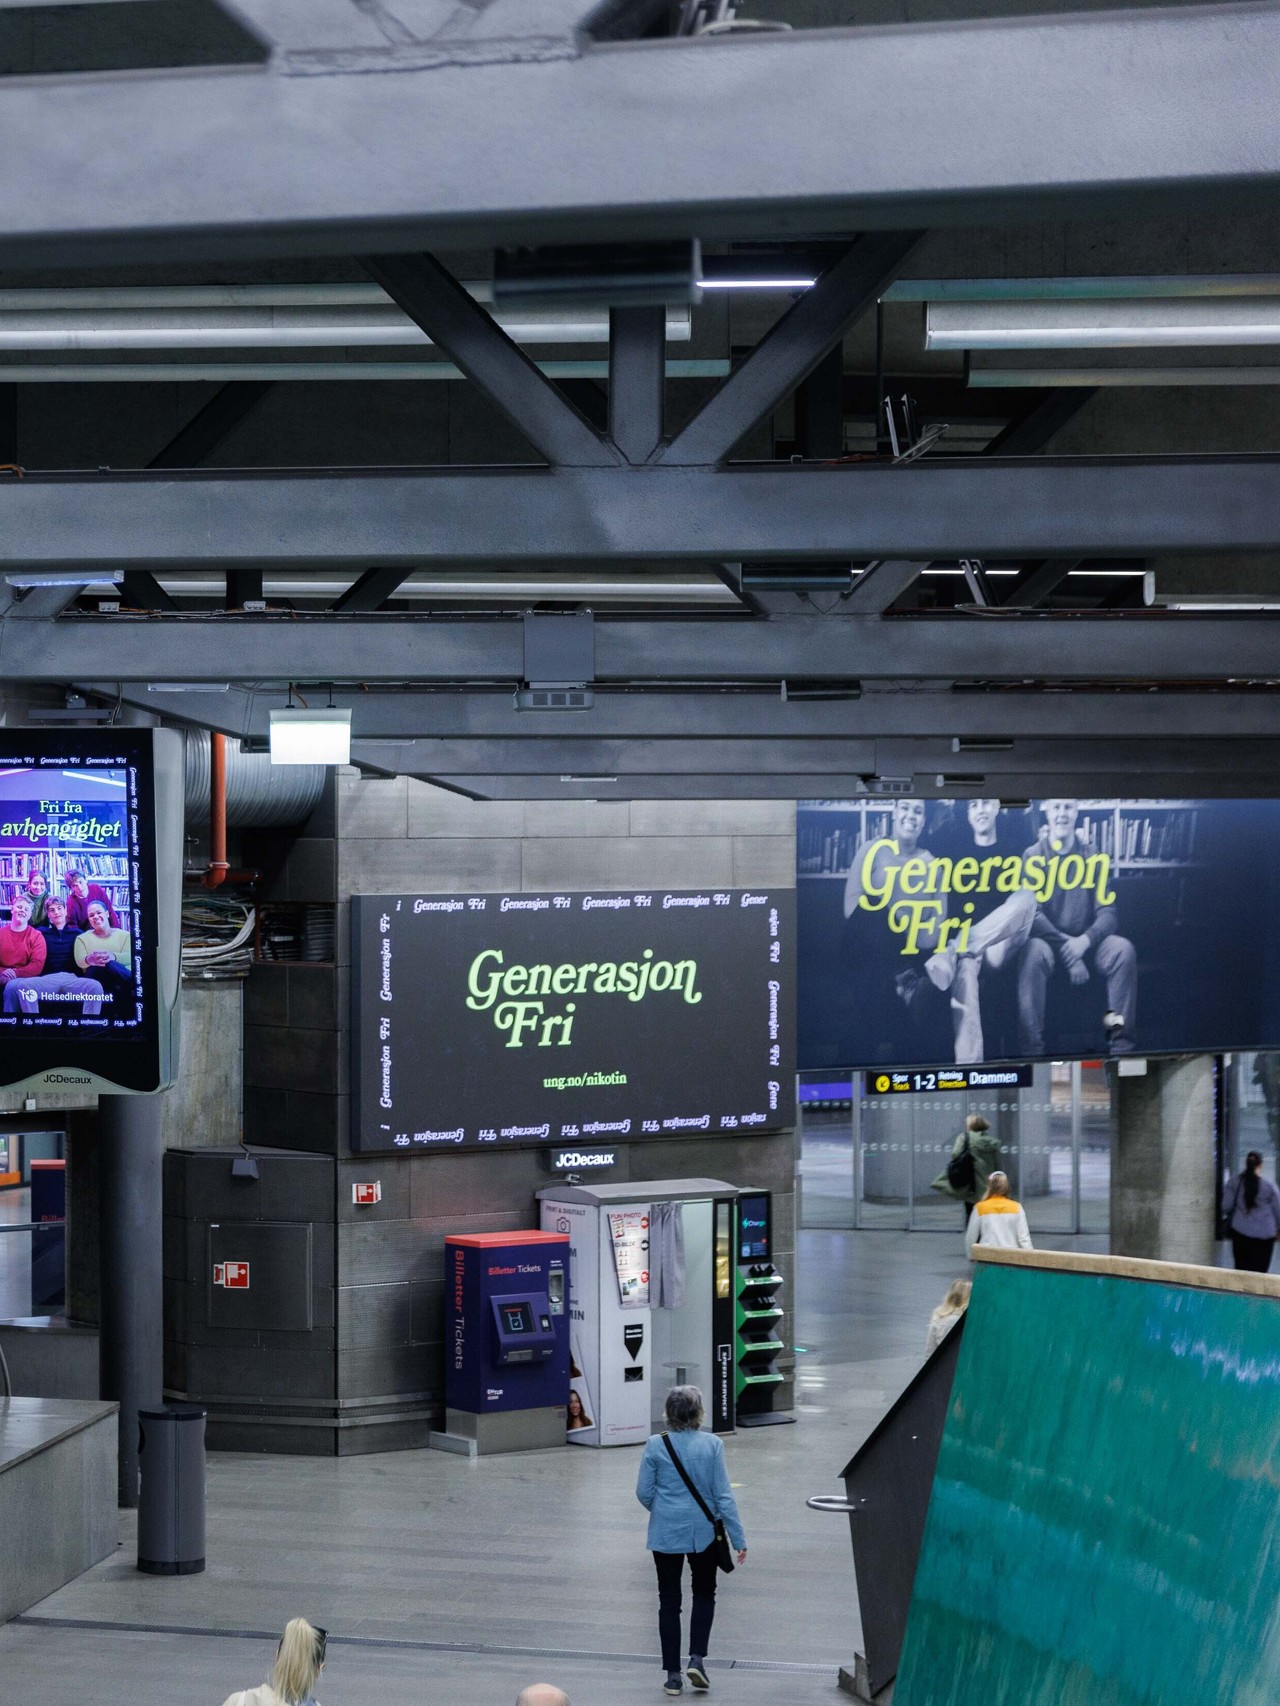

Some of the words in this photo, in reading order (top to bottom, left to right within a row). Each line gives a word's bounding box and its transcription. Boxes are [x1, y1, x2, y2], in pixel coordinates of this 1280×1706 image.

[39, 800, 60, 813] Fri
[63, 800, 83, 813] fra
[0, 817, 121, 843] avhengighet
[859, 838, 1116, 911] Generasjon
[413, 899, 464, 913] Generasjon
[468, 898, 486, 911] Fri
[500, 897, 550, 912] Generasjon
[552, 896, 571, 909] Fri
[582, 896, 630, 911] Generasjon
[633, 895, 652, 907] Fri
[662, 894, 710, 910] Generasjon
[713, 894, 731, 907] Fri
[888, 900, 976, 955] Fri
[770, 941, 780, 963] Fri
[380, 938, 392, 1001] Generasjon
[465, 948, 703, 1010] Generasjon
[41, 991, 114, 1002] Helsedirektoratet
[768, 980, 780, 1040] Generasjon
[380, 1017, 390, 1040] Fri
[494, 1001, 577, 1048] Fri
[770, 1044, 780, 1066] Fri
[43, 1074, 92, 1084] JCDecaux
[380, 1045, 392, 1108] Generasjon
[543, 1071, 627, 1090] ung.no/nikotin
[913, 1074, 936, 1090] 1-2
[970, 1072, 1017, 1085] Drammen
[560, 1124, 579, 1136] Fri
[582, 1119, 631, 1134] Generasjon
[642, 1120, 660, 1132] Fri
[662, 1114, 711, 1129] Generasjon
[720, 1115, 738, 1127] Fri
[414, 1127, 464, 1143] Generasjon
[478, 1129, 497, 1141] Fri
[500, 1123, 550, 1139] Generasjon
[555, 1153, 614, 1167] JCDecaux
[488, 1266, 517, 1276] Billetter
[517, 1264, 541, 1274] Tickets
[455, 1250, 464, 1312] Billetter
[455, 1317, 465, 1369] Tickets
